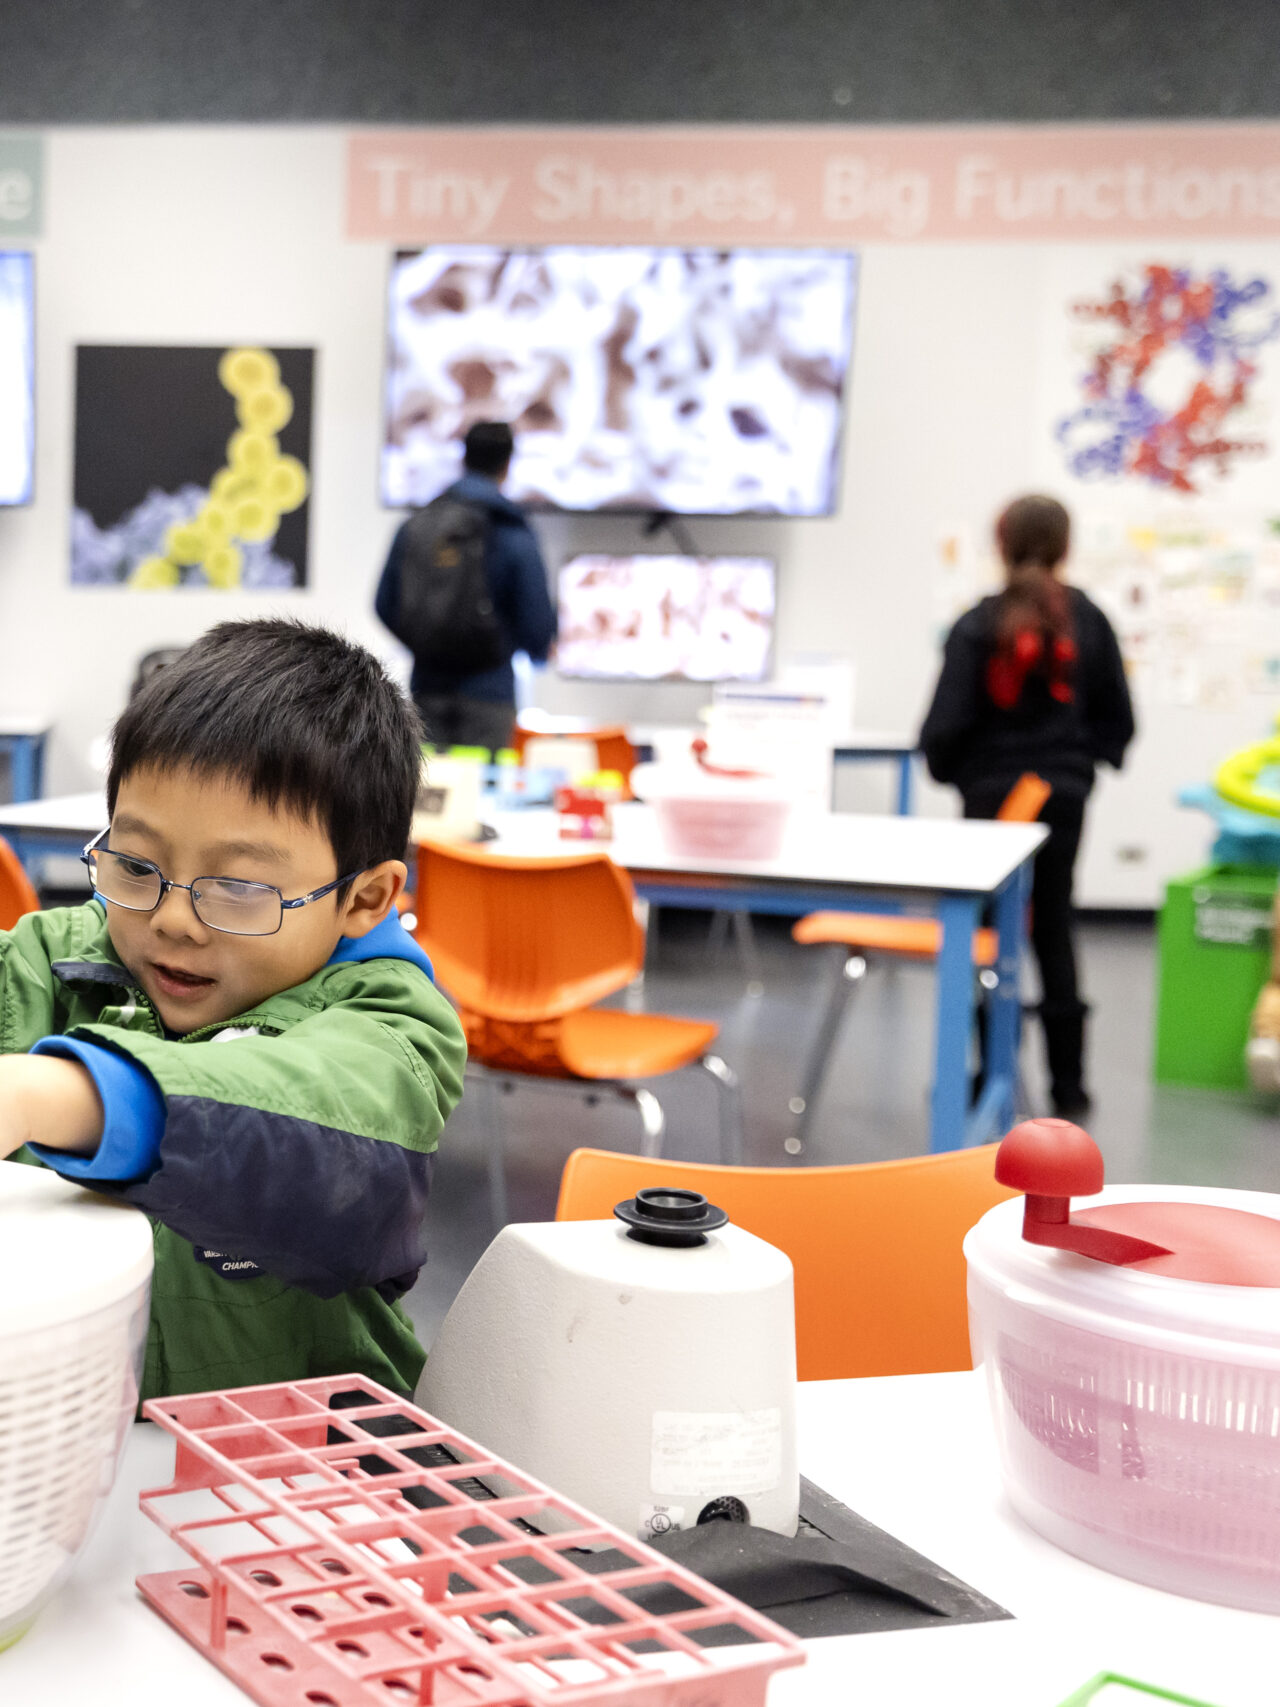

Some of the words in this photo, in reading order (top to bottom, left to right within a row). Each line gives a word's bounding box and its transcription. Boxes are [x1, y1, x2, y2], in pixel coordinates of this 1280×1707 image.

[368, 154, 510, 236] Tiny
[532, 153, 796, 236] Shapes,
[821, 153, 931, 238] Big
